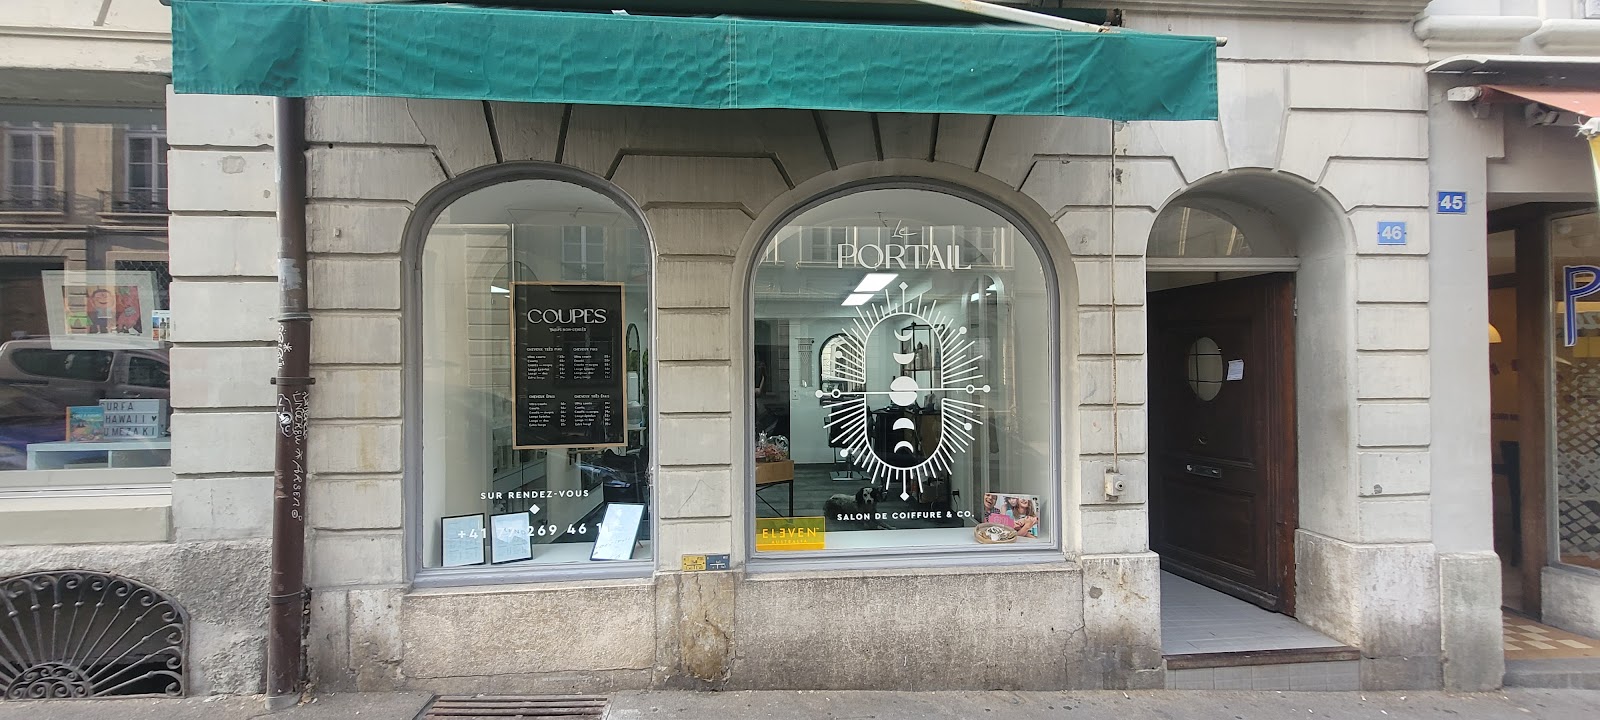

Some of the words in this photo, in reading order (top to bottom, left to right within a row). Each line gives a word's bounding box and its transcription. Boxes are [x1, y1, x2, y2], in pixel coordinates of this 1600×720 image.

[1440, 195, 1463, 210] 45
[891, 220, 917, 238] Le
[1381, 225, 1402, 240] 46
[837, 243, 972, 270] PORTAIL
[527, 308, 607, 324] COUPES
[105, 415, 145, 423] HAWAII
[480, 491, 503, 500] SUR
[508, 489, 589, 499] RENDEZ-VOUS
[836, 512, 871, 521] SALON
[874, 512, 888, 520] DE
[891, 511, 942, 520] COIFFURE
[946, 510, 953, 518] &
[457, 528, 487, 539] +41
[527, 524, 558, 537] 269
[566, 523, 587, 535] 46
